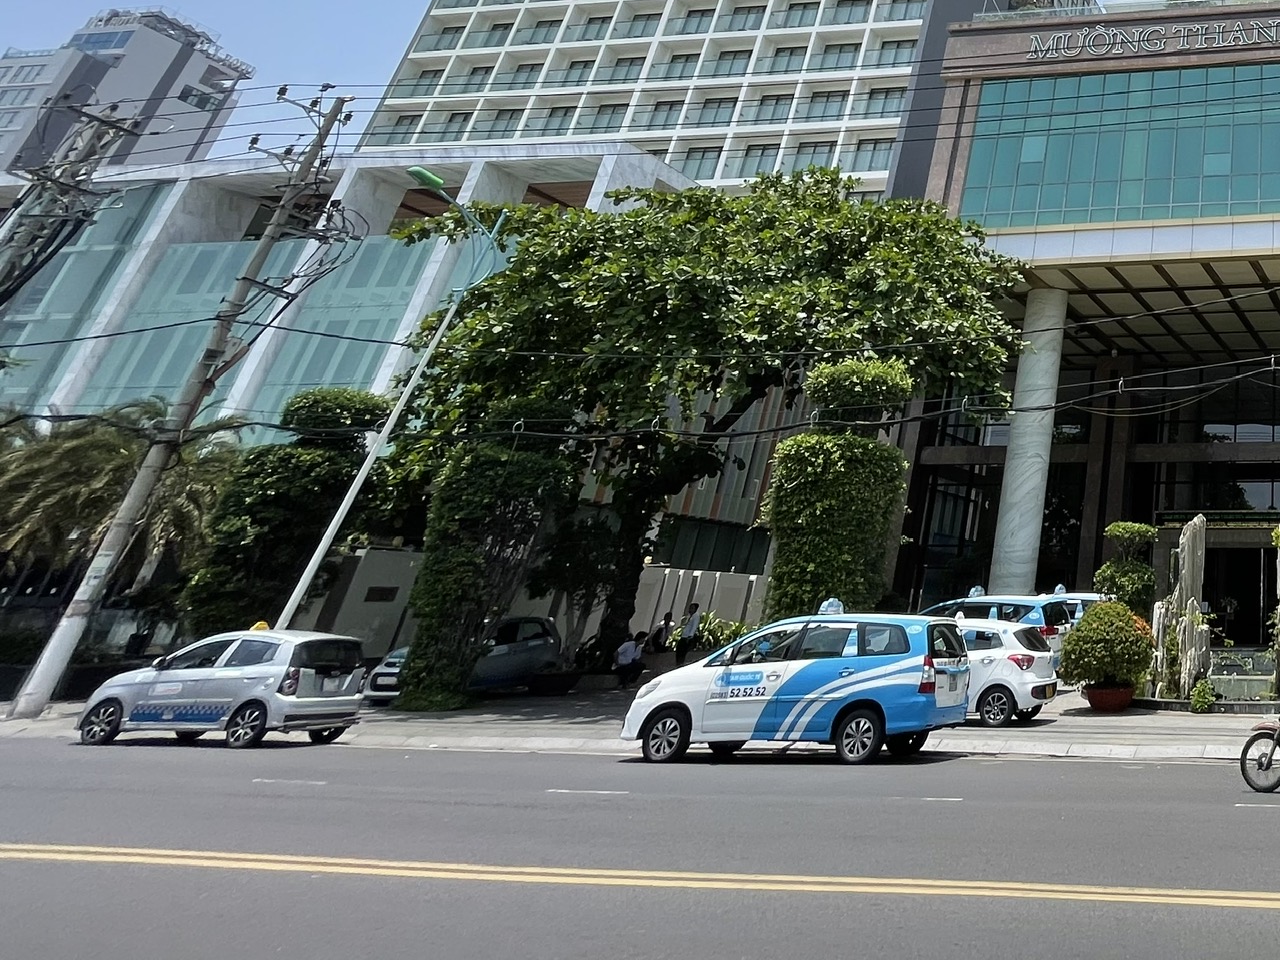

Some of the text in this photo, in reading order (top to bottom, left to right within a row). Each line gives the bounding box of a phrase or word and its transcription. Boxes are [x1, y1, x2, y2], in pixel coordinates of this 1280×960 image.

[1026, 24, 1166, 60] MƯỜNG
[729, 686, 767, 698] 52 52 52
